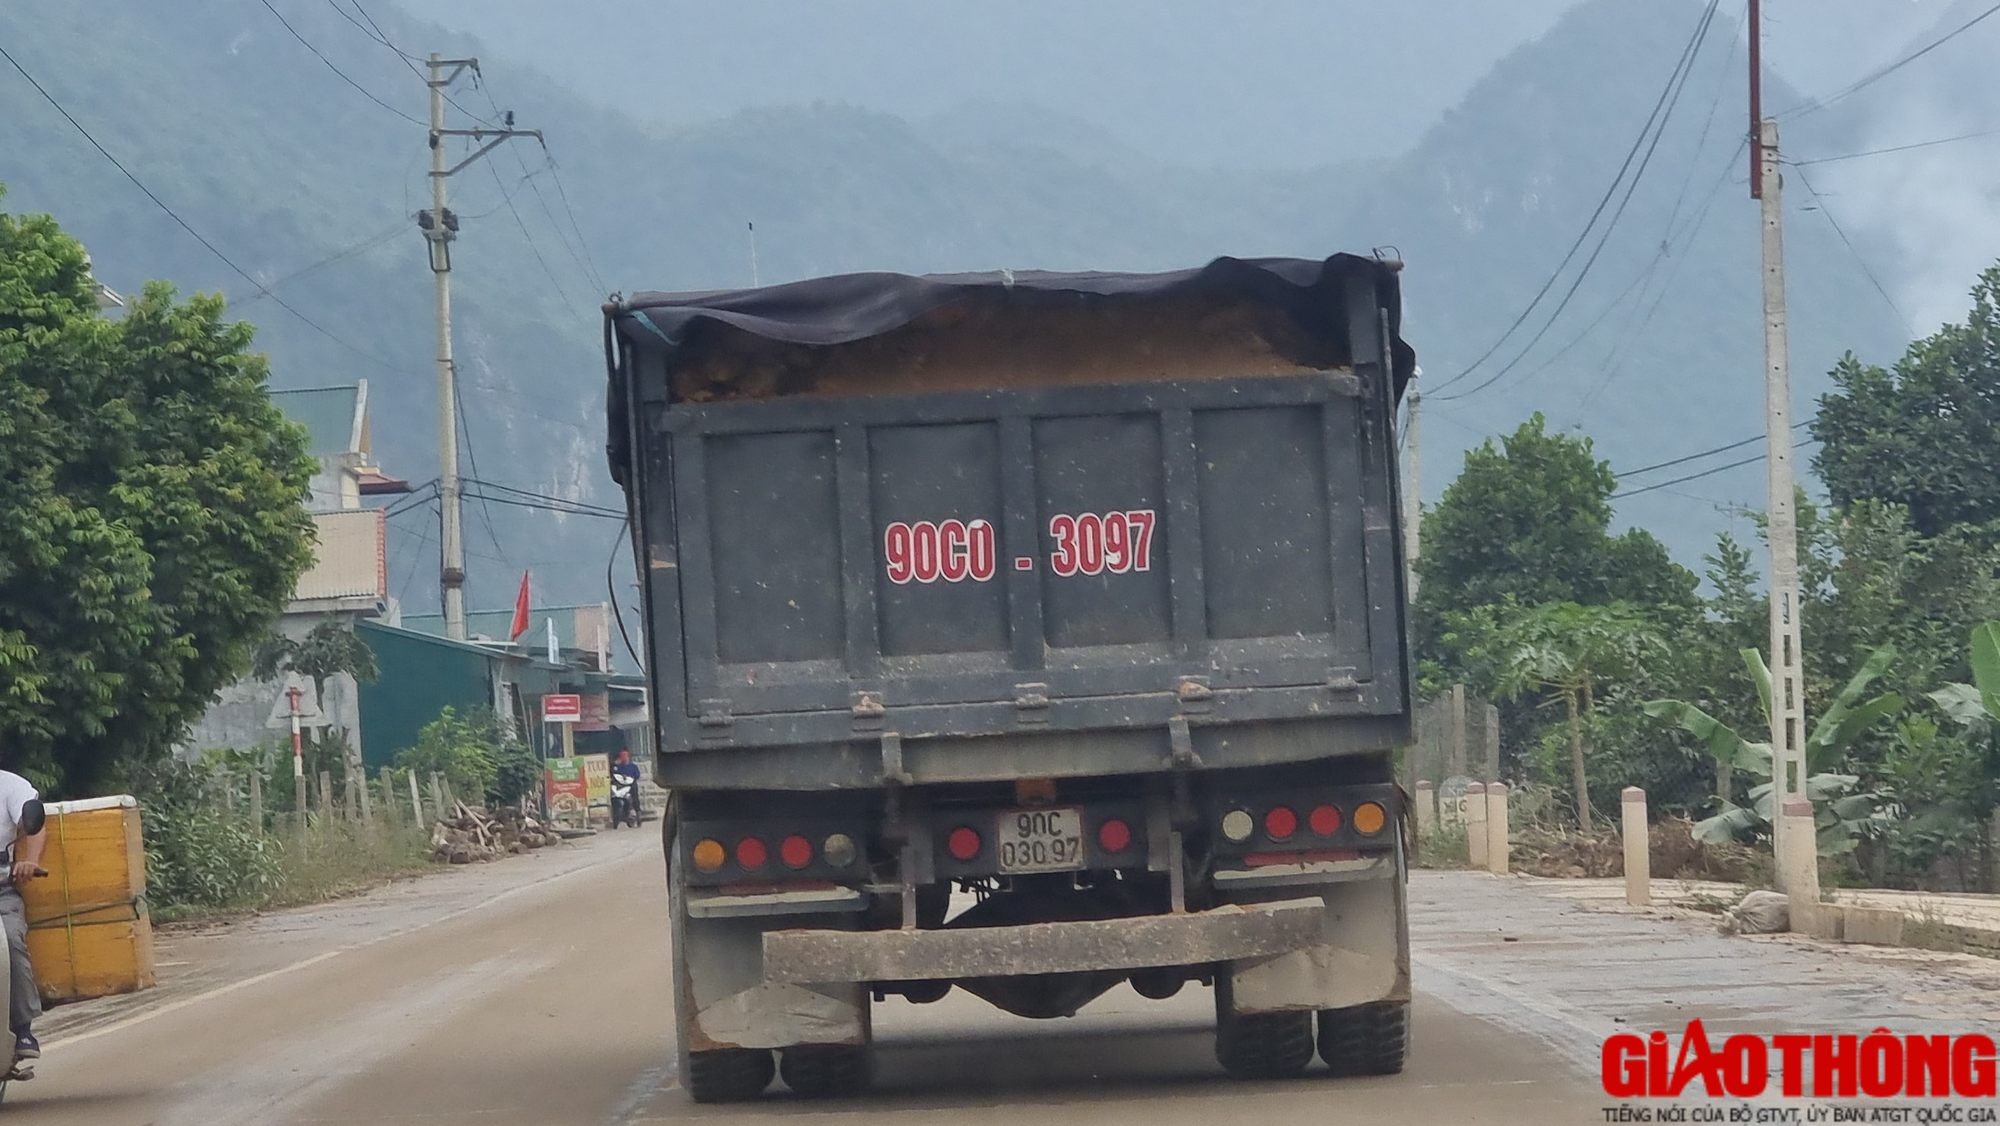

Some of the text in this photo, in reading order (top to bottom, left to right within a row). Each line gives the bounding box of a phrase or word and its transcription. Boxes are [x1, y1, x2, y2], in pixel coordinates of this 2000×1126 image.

[885, 518, 996, 584] 90C0
[1050, 510, 1155, 577] 3097
[1018, 811, 1062, 838] 90C
